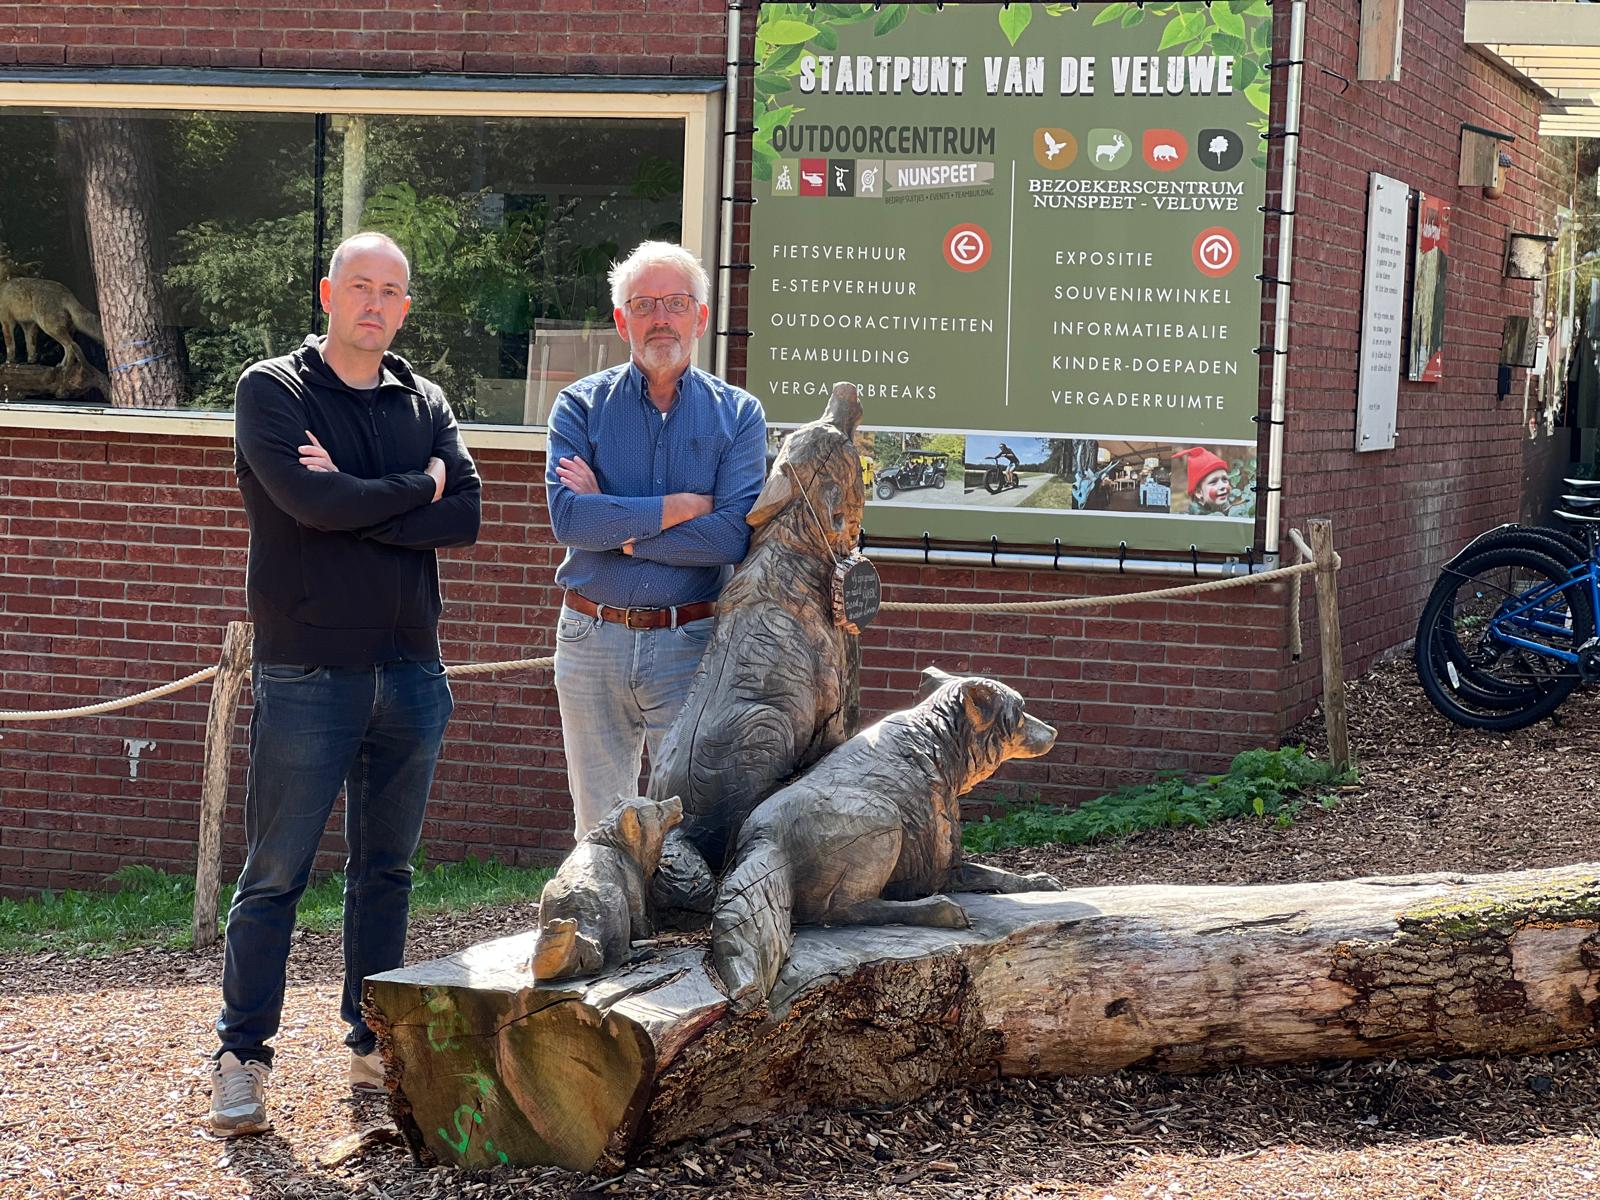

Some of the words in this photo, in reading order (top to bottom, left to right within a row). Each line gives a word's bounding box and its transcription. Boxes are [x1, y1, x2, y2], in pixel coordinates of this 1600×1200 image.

[799, 55, 968, 95] STARTPUNT
[983, 56, 1046, 95] VAN
[1060, 56, 1097, 96] DE
[1111, 55, 1235, 96] VELUWE
[772, 124, 996, 155] OUTDOORCENTRUM
[898, 163, 977, 187] NUNSPEET
[929, 192, 951, 201] EVENTS
[955, 188, 995, 199] TEAMBUILDING
[1028, 179, 1245, 195] BEZOEKERSCENTRUM
[1033, 194, 1137, 209] NUNSPEET
[1152, 196, 1239, 211] VELUWE
[772, 243, 907, 262] FIETSVERHUUR
[1055, 250, 1154, 268] EXPOSITIE
[772, 278, 917, 297] E-STEPVERHUUR
[1054, 285, 1232, 305] SOUVENIRWINKEL
[771, 312, 994, 334] OUTDOORACTIVITEITEN
[1053, 320, 1228, 340] INFORMATIEBALIE
[769, 346, 910, 365] TEAMBUILDING
[1051, 355, 1238, 376] KINDER-DOEPADEN
[769, 381, 937, 400] VERGARBREAKS
[1051, 390, 1225, 411] VERGADERRUIMTE
